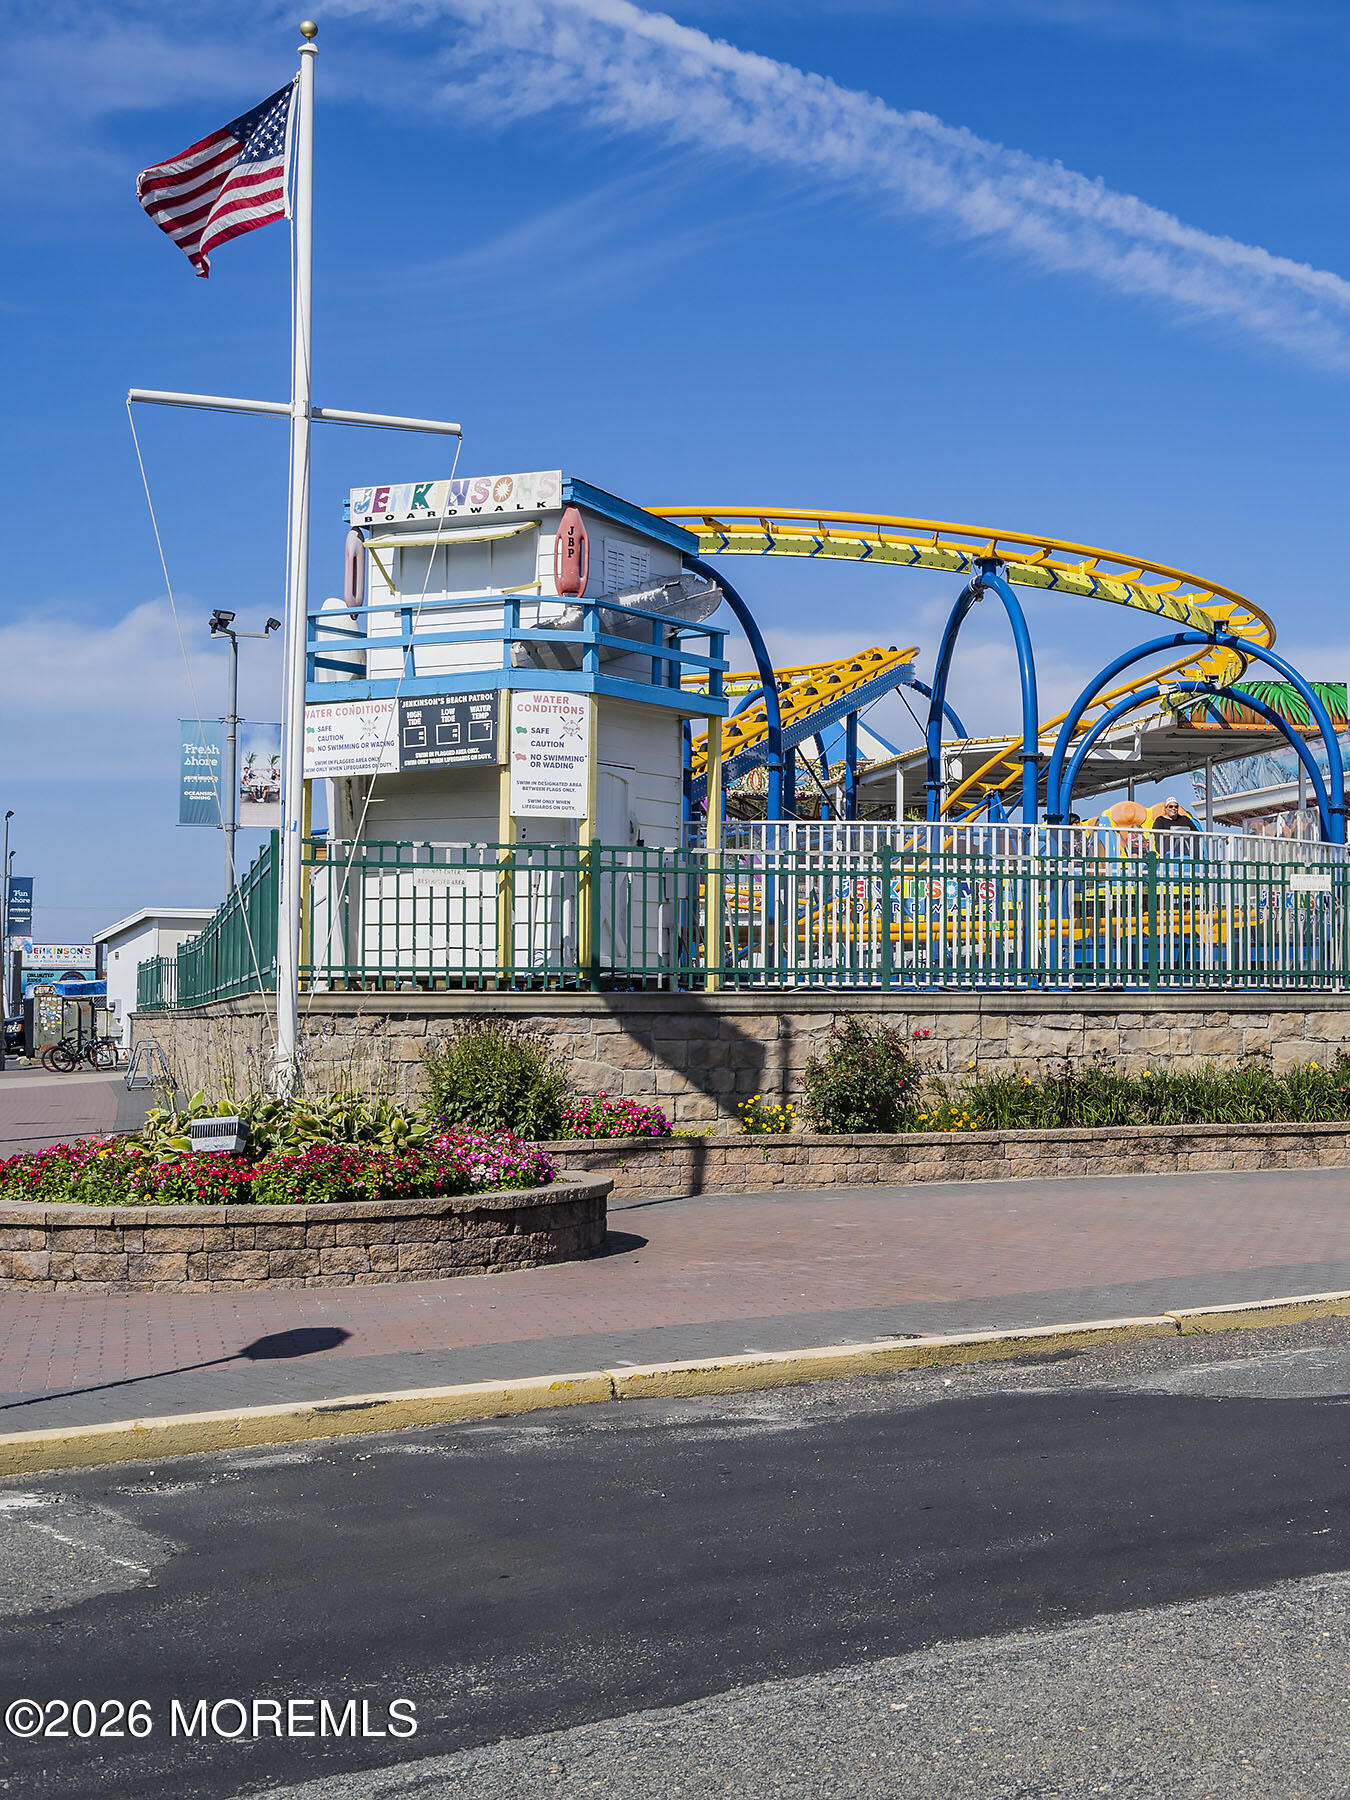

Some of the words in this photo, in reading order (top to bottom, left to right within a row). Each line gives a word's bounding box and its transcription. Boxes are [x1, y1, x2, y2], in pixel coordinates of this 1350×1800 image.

[364, 501, 547, 523] BOARDWALK
[402, 698, 445, 709] JENKINSON'S
[446, 695, 468, 705] BEACH
[468, 692, 494, 702] PATROL
[533, 695, 569, 704] WATER
[335, 703, 394, 717] CONDITIONS
[441, 708, 456, 716] LOW
[469, 704, 492, 713] WATER
[517, 704, 585, 715] CONDITIONS
[406, 711, 422, 719] HIGH
[441, 715, 456, 723] TIDE
[471, 712, 490, 720] TEMP
[407, 718, 422, 726] TIDE
[318, 725, 332, 733] SAFE
[531, 727, 550, 735] SAFE
[317, 734, 344, 743] CAUTION
[327, 742, 360, 752] SWIMMING
[530, 740, 565, 748] CAUTION
[182, 743, 220, 755] Fresh
[183, 756, 218, 766] shore
[543, 755, 585, 763] SWIMMING
[543, 762, 574, 770] WADING
